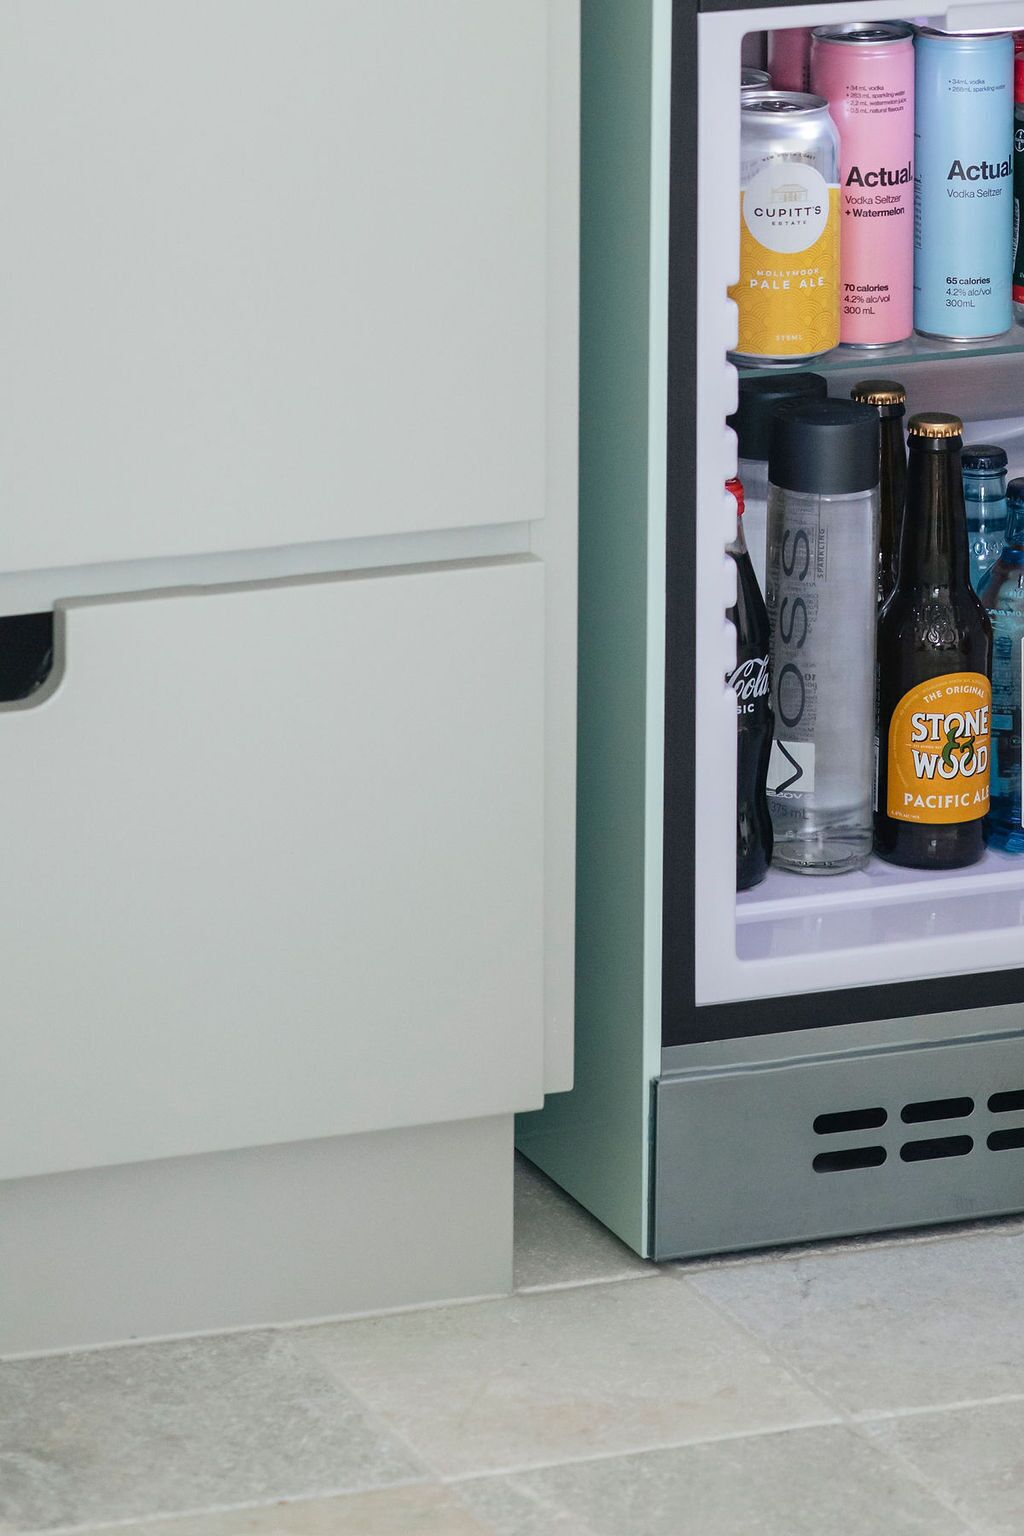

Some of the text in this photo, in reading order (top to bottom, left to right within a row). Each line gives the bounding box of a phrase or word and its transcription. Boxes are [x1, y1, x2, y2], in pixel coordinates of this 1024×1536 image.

[947, 187, 1003, 198] Vodka Seltzer
[845, 194, 902, 205] Vodka Seltzer
[754, 206, 822, 218] CUPITT'S
[852, 206, 905, 218] Watermelon
[750, 276, 824, 289] PALE ALE
[946, 276, 991, 285] 65 calories
[844, 283, 889, 292] 70 calories
[945, 287, 992, 296] 4.2% alc/vol
[844, 294, 891, 304] 4.2% alc/vol
[945, 299, 975, 308] 300mL
[844, 306, 875, 315] 300 mL
[817, 528, 825, 578] SPARKLING
[923, 685, 985, 704] THE ORIGINAL
[911, 705, 990, 742] STONE
[942, 726, 975, 767] &
[911, 746, 988, 779] WOOD
[904, 785, 990, 809] PACIFIC ALE
